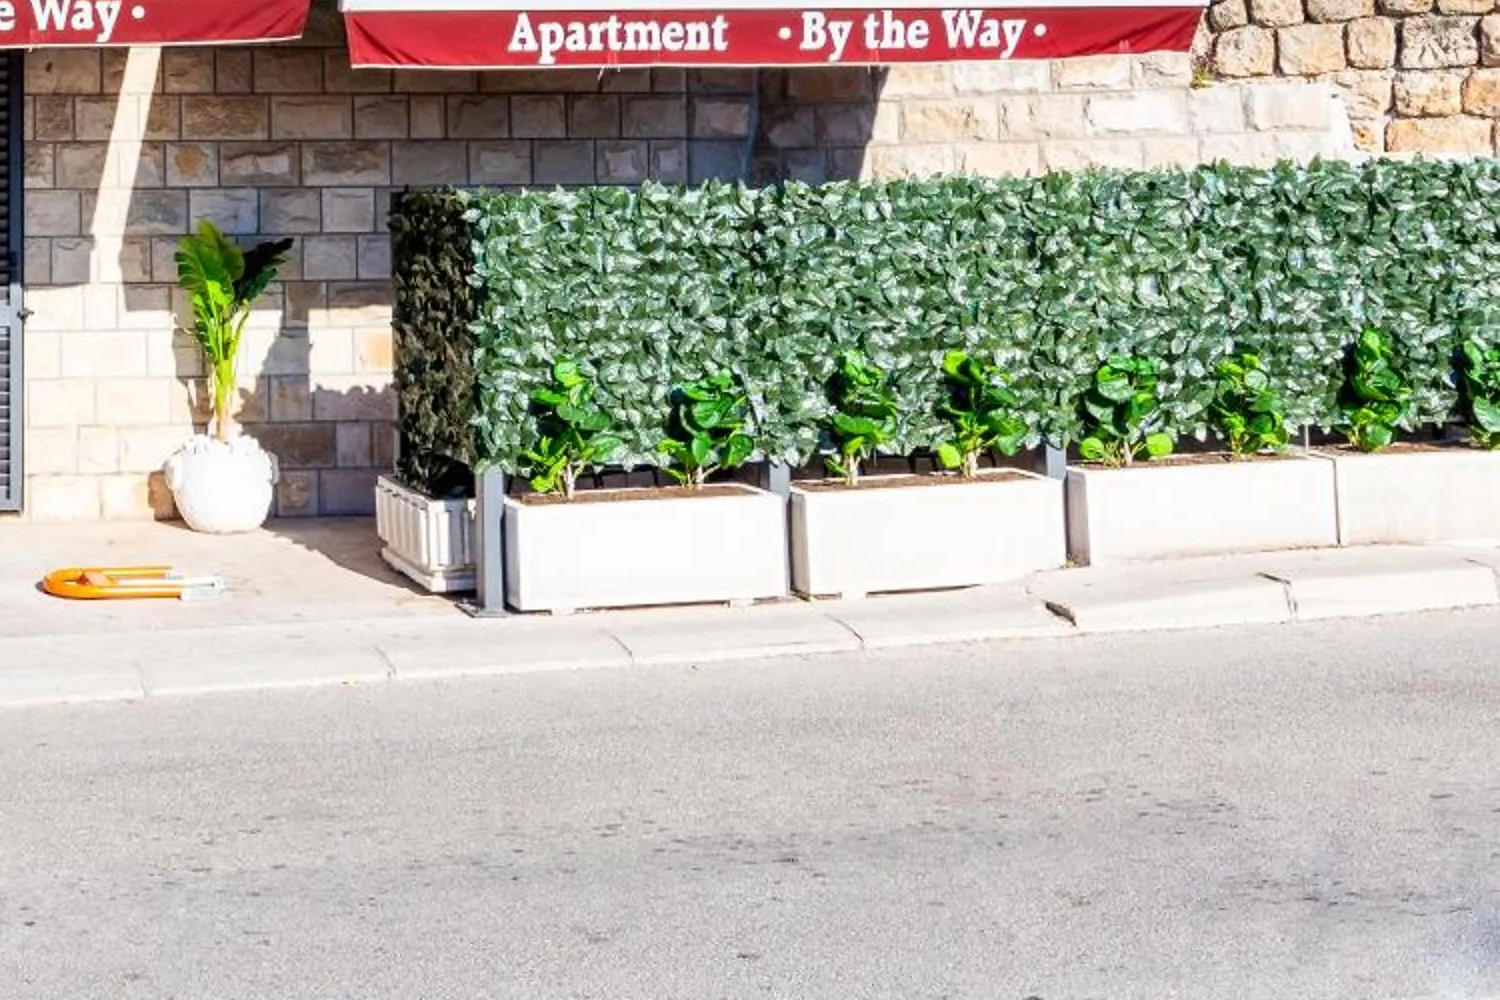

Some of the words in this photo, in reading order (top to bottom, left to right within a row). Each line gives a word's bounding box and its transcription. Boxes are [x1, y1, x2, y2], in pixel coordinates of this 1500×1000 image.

[508, 12, 728, 64] Apartment
[800, 11, 852, 60] By
[864, 10, 929, 50] the
[941, 10, 1026, 58] Way
